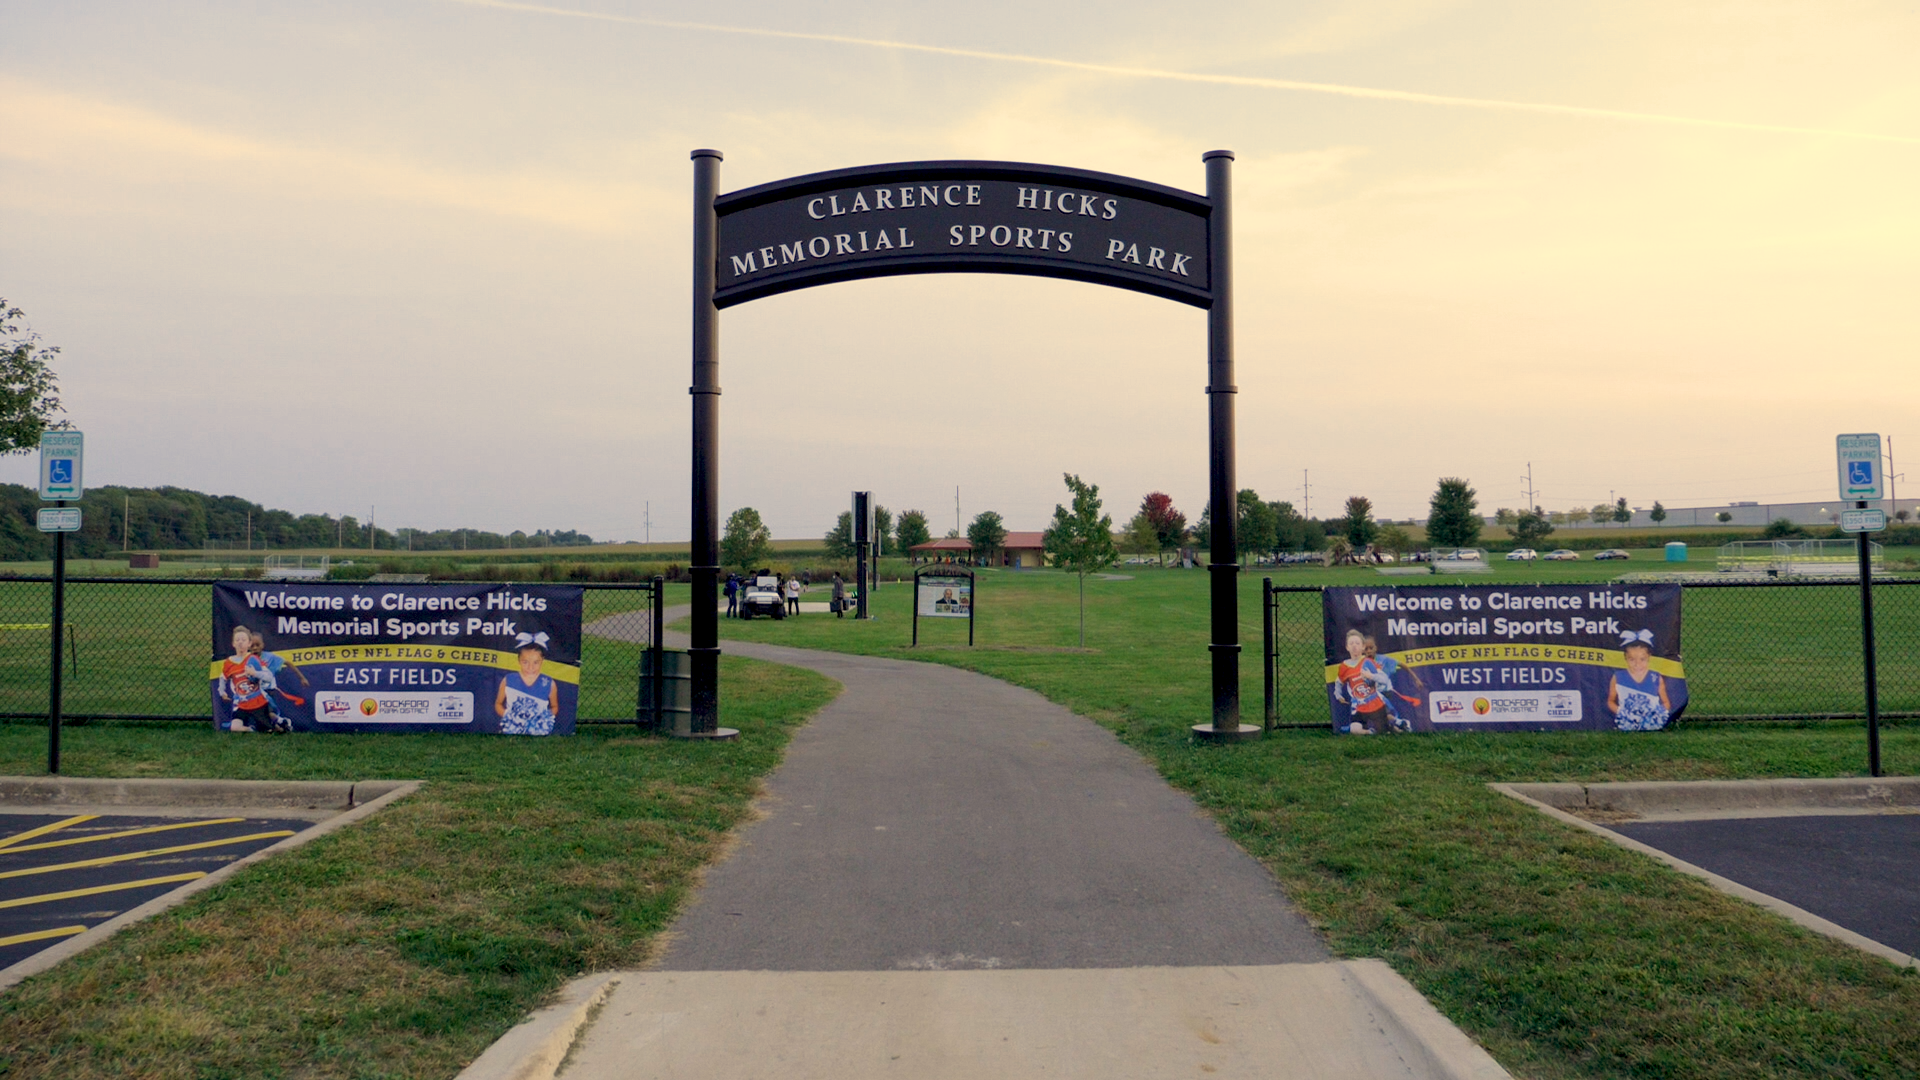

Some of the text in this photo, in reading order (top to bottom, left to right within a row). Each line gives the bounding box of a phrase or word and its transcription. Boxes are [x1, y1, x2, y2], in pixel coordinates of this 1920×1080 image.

[807, 184, 1119, 220] CLARENCE HICKS
[730, 224, 1193, 276] MEMORIAL SPORTS PARK
[43, 436, 81, 446] RESERVED
[1839, 439, 1879, 448] RESERVED
[45, 448, 78, 457] PARKING
[1842, 450, 1877, 459] PARKING
[245, 590, 547, 611] Welcome to Clarence Hicks
[1354, 591, 1647, 611] Welcome to Clarence Hicks
[278, 616, 516, 639] Memorial Sports Park
[1387, 617, 1619, 639] Memorial Sports Park
[292, 648, 498, 663] HOME OF NFL FLAG & CHEER
[1405, 647, 1605, 664] HOME OF NFL FLAG & CHEER
[333, 668, 457, 685] EAST FIELDS
[1442, 667, 1566, 684] WEST FIELDS
[326, 701, 350, 711] FLAG
[379, 700, 429, 708] ROCKFORD
[1491, 699, 1539, 707] ROCKFORD
